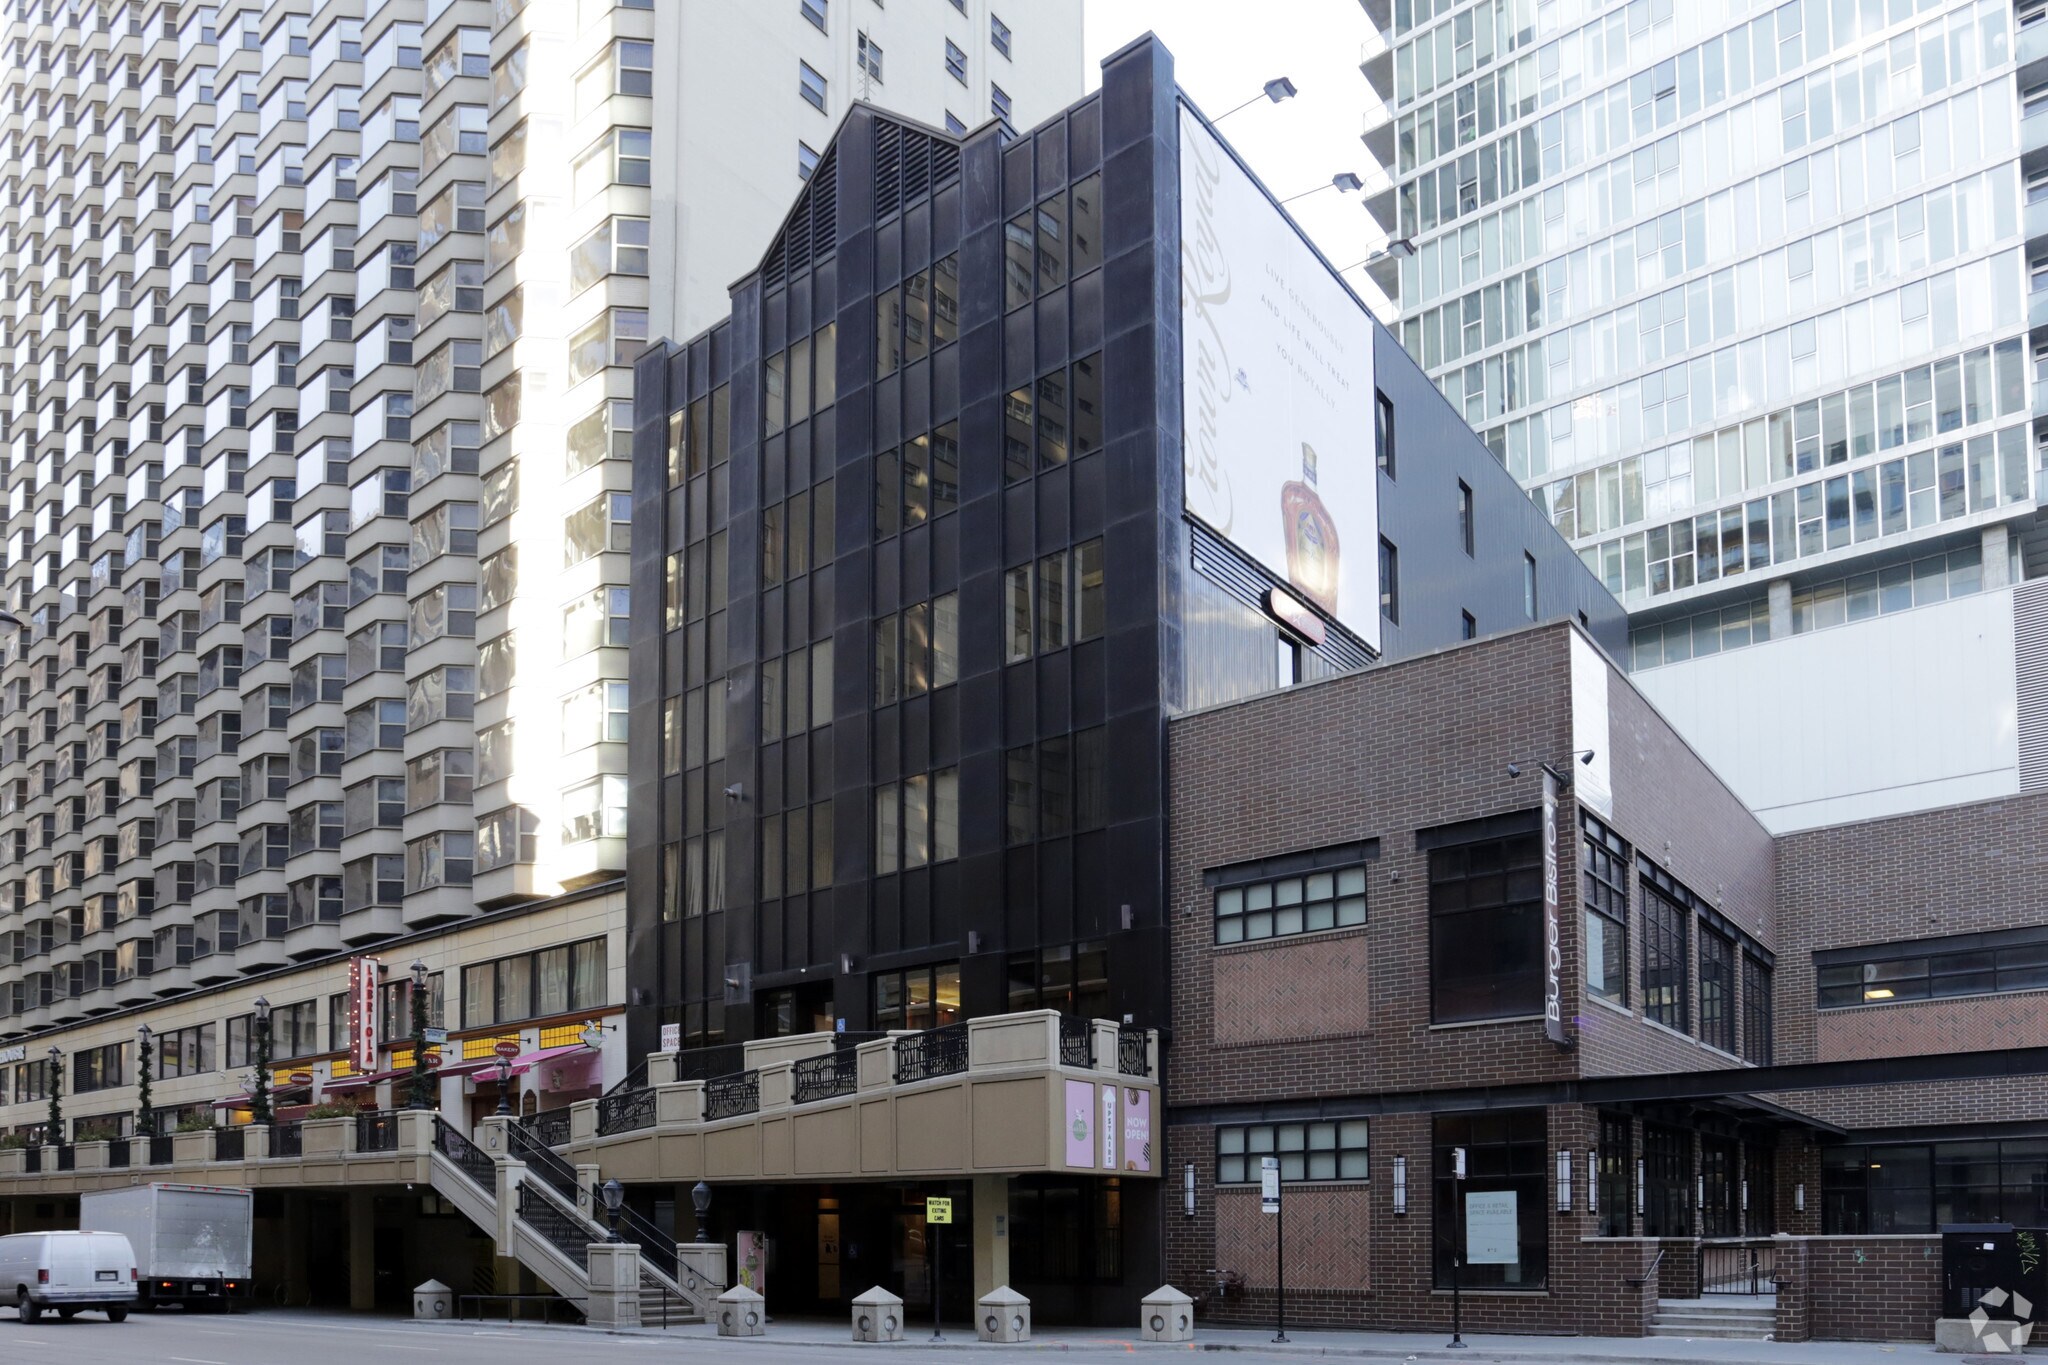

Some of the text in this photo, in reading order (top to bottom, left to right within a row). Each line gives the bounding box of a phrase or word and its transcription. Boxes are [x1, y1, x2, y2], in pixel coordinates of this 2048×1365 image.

[1260, 293, 1350, 392] AND LIFE WILL TREAT
[1265, 263, 1345, 354] LIVE GENEROUSLY
[1276, 341, 1294, 367] YOU
[1545, 820, 1558, 905] Bistro
[1546, 914, 1561, 1022] Burger
[366, 964, 374, 1063] LABRIOLA
[1125, 1129, 1149, 1140] OPEN!
[1126, 1117, 1148, 1128] NOW
